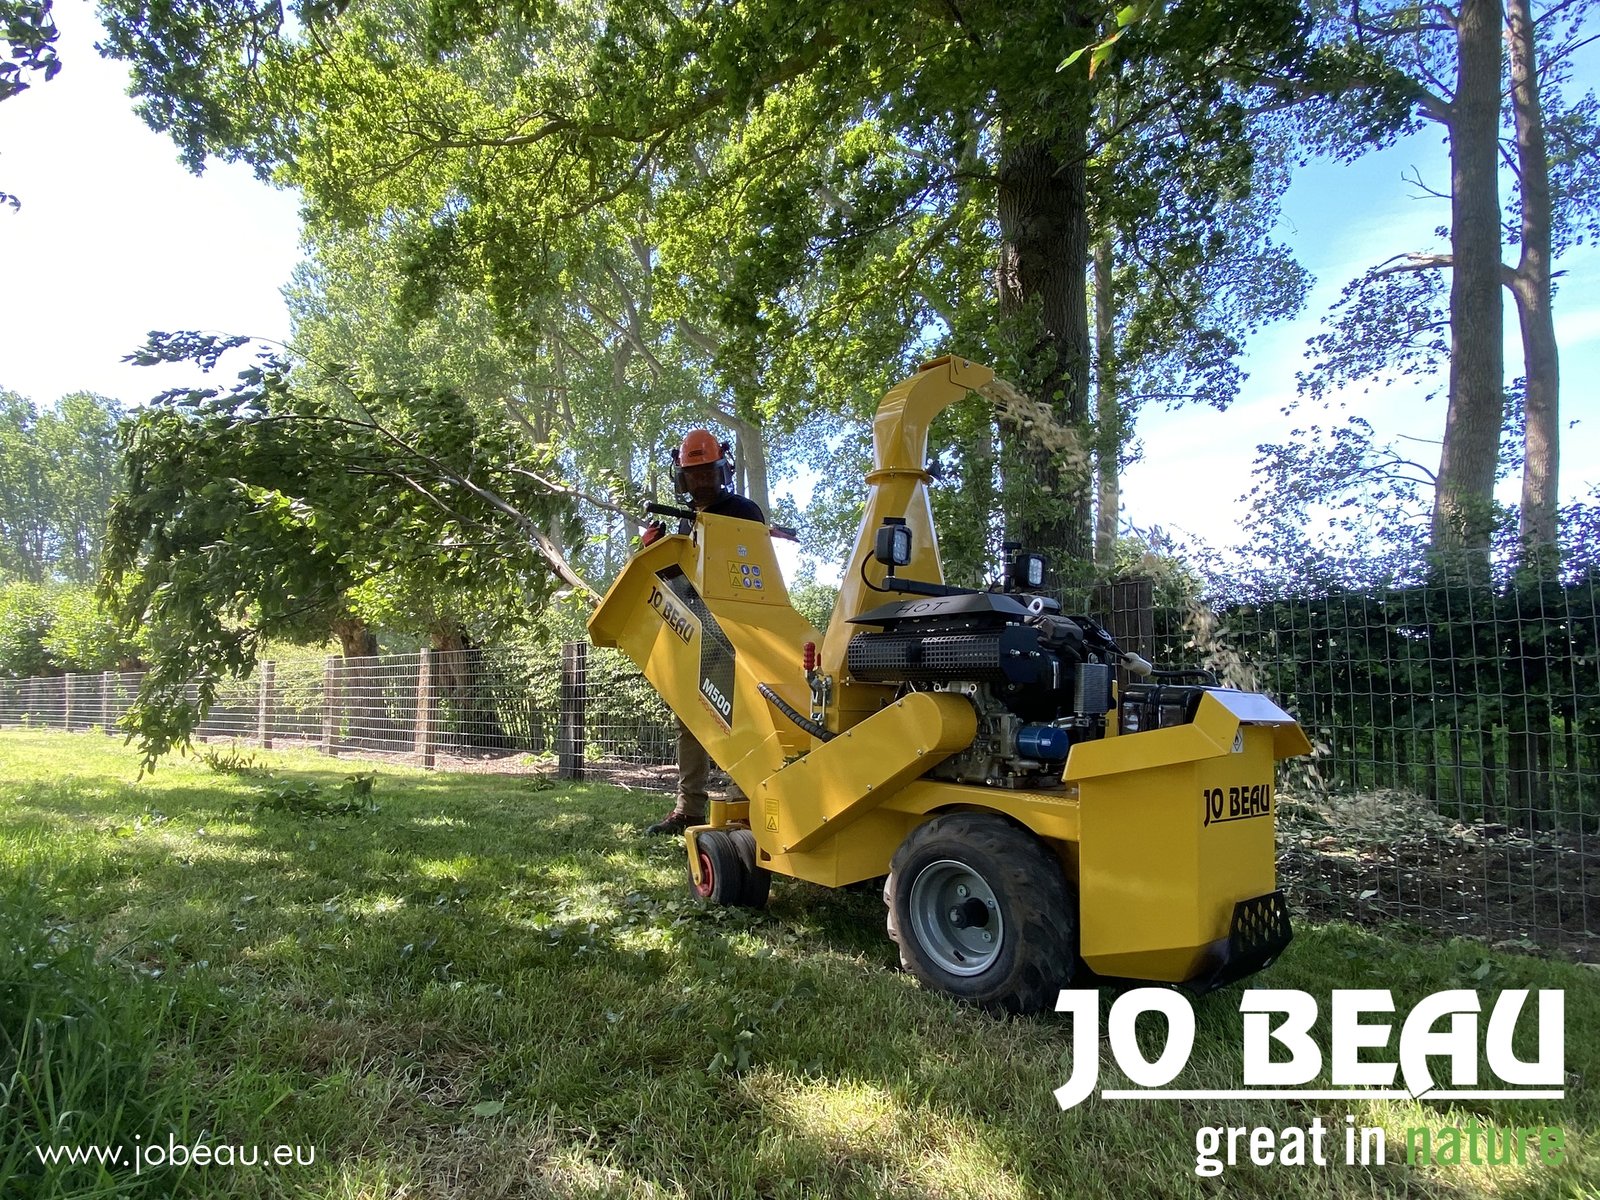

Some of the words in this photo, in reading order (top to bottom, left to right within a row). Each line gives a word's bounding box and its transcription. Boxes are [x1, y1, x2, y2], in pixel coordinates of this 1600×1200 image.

[648, 586, 663, 608] JO
[662, 601, 694, 643] BEAU
[895, 601, 950, 614] HOT
[702, 677, 731, 716] M500
[1204, 788, 1223, 828] JO
[1229, 784, 1269, 817] BEAU
